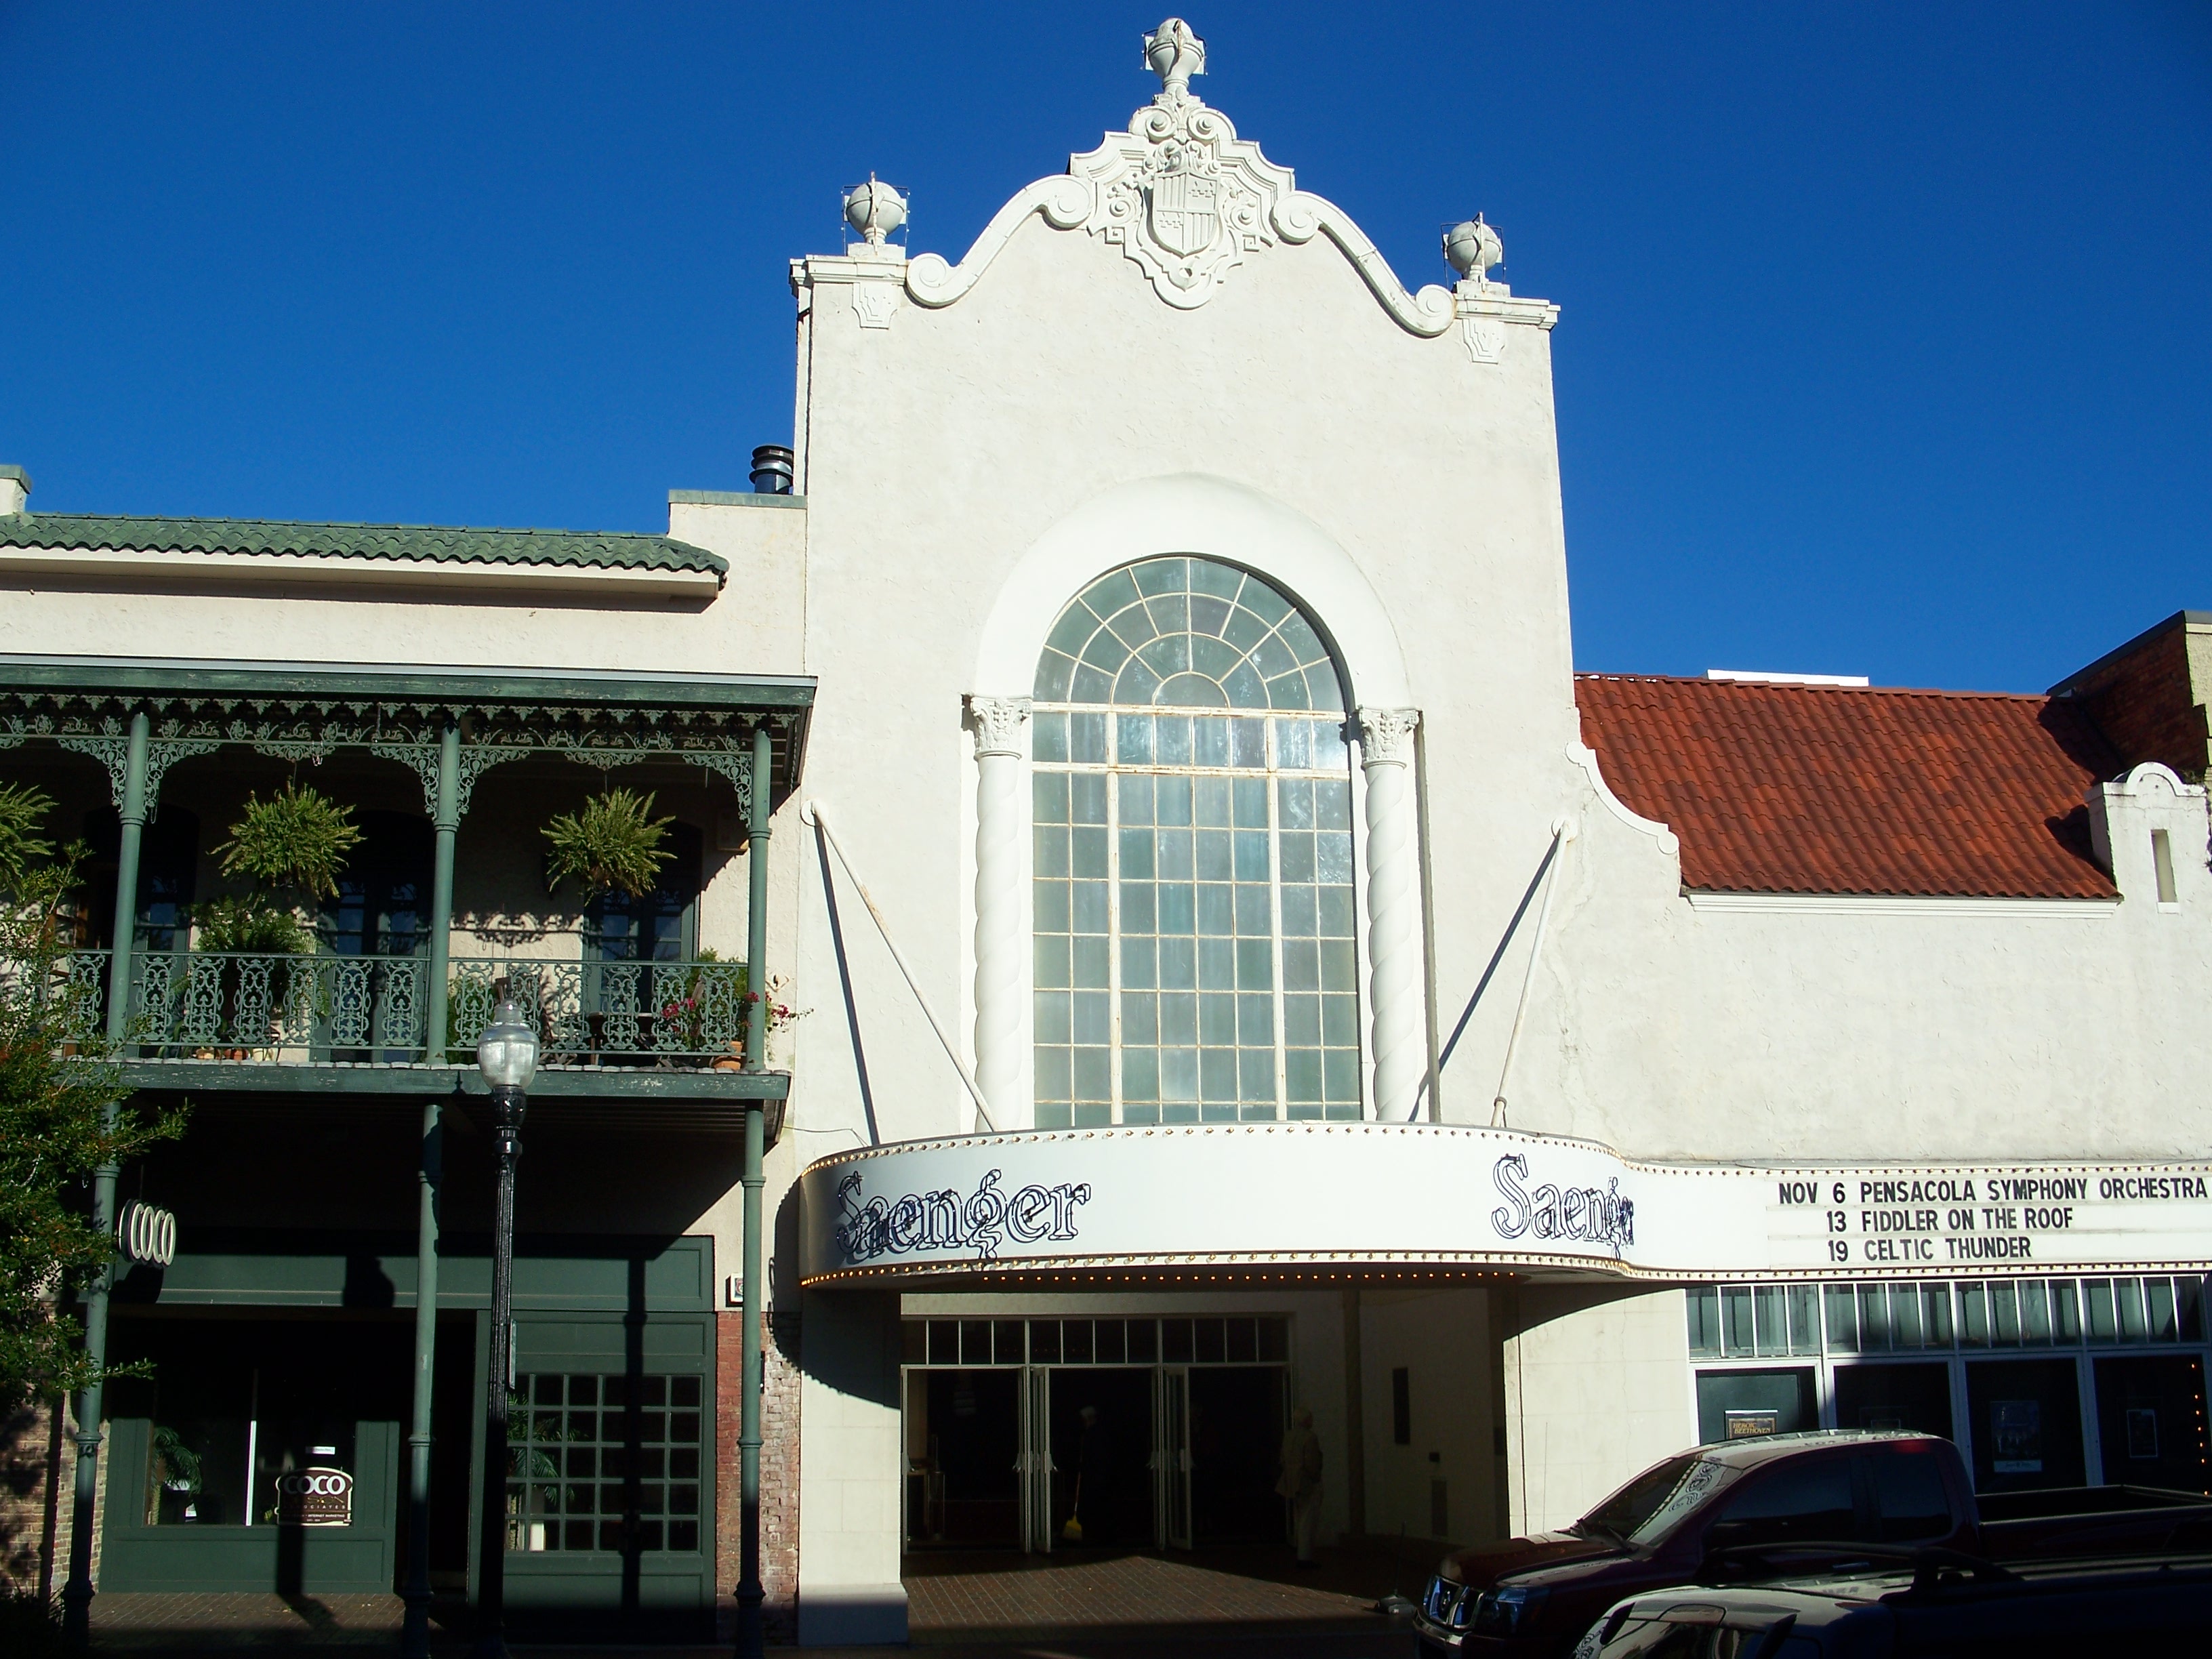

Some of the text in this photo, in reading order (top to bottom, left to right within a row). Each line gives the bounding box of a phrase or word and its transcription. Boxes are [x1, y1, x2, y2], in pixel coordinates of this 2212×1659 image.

[1779, 1177, 2208, 1204] NOV 6 PENSACOLA SYMPHONY ORCHESTRA
[837, 1169, 1090, 1260] Saenger
[1827, 1207, 2072, 1232] 13 FIDDLER ON THE ROOF
[131, 1203, 176, 1266] COCO
[1828, 1237, 2031, 1261] 19 CELTIC THUNDER
[283, 1475, 346, 1495] COCO
